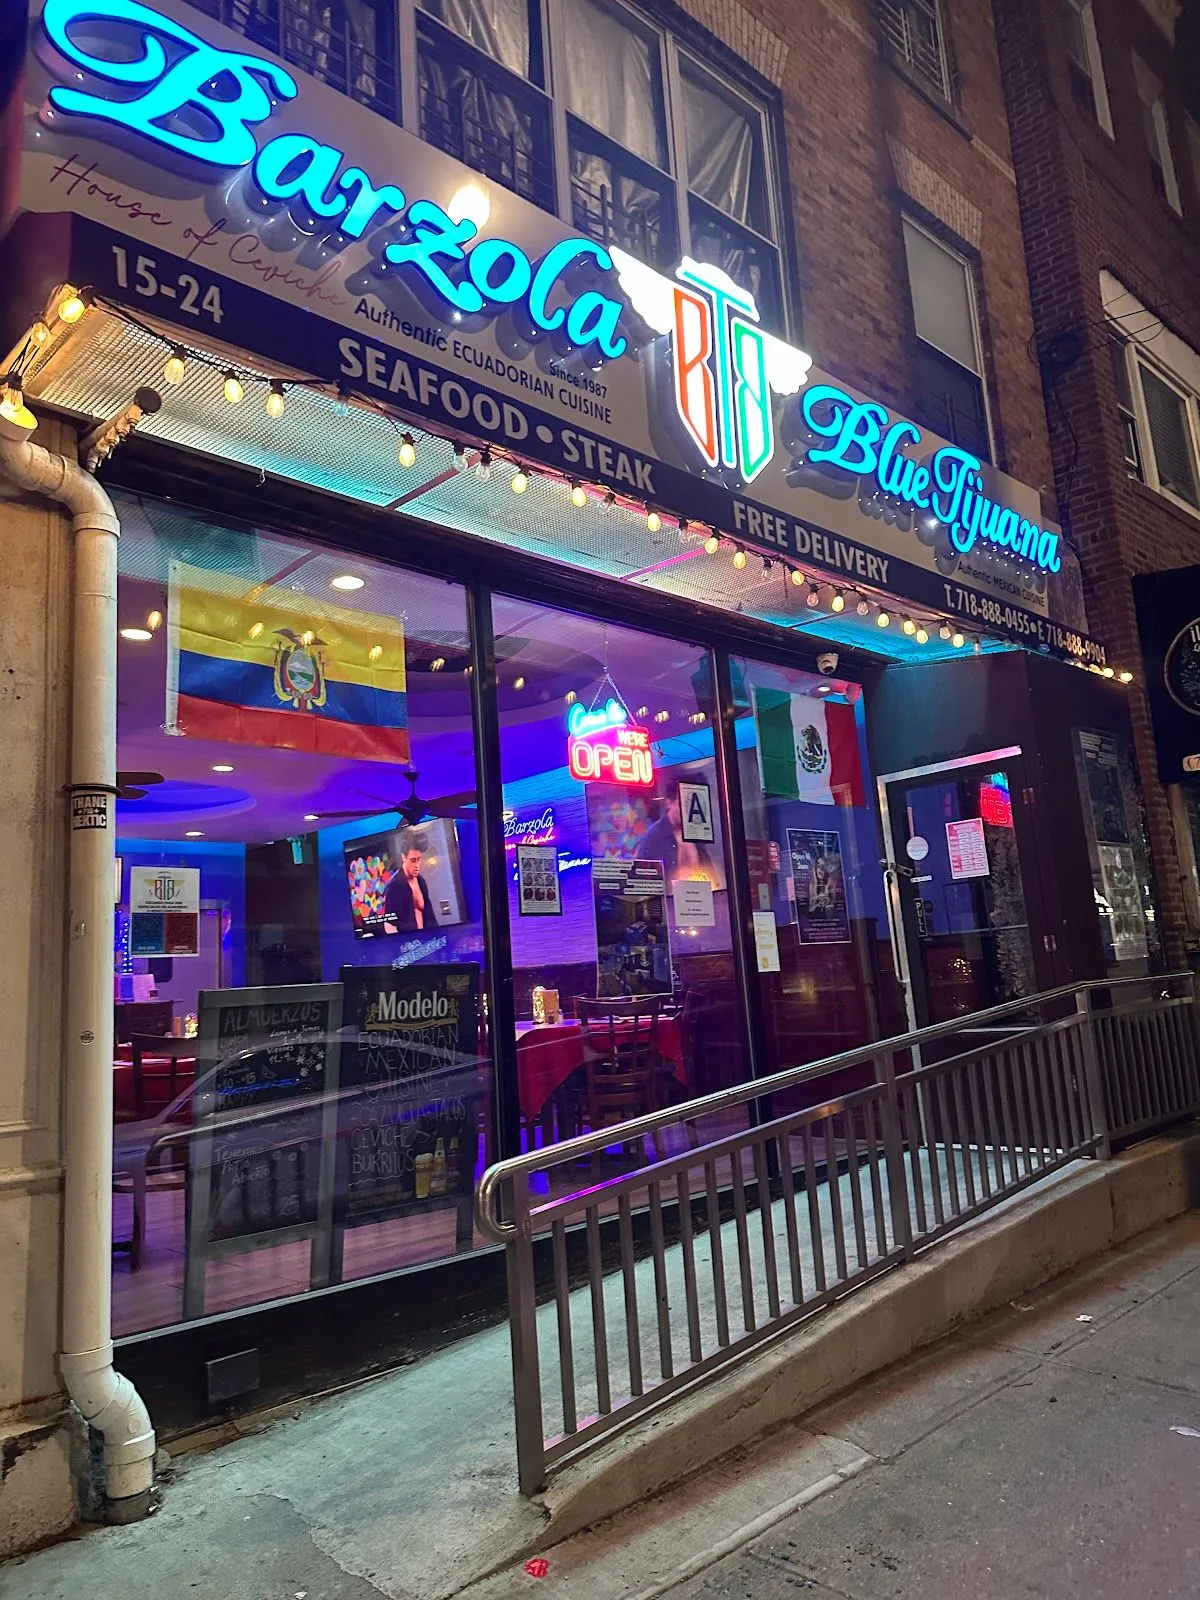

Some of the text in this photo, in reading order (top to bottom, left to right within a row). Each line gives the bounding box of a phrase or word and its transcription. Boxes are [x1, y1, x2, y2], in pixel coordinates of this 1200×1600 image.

[41, 0, 628, 360] Barzola
[50, 154, 346, 306] House of Ceviche
[112, 246, 224, 324] 15-24
[354, 298, 612, 424] Authentic ECUADORIAN CUISINE
[549, 361, 607, 399] Since 1987
[337, 337, 656, 494] SEAFOOD STEAK
[802, 384, 1061, 574] Blue Tijuana
[733, 500, 889, 584] FREE DELIVERY
[957, 560, 1046, 608] Authentic MEXICAN CUISINE
[571, 740, 653, 783] OPEN
[504, 807, 554, 838] Barzola
[687, 792, 707, 824] A
[915, 901, 926, 933] PULL
[377, 989, 448, 1022] Modelo
[364, 1041, 456, 1075] MEXICAN
